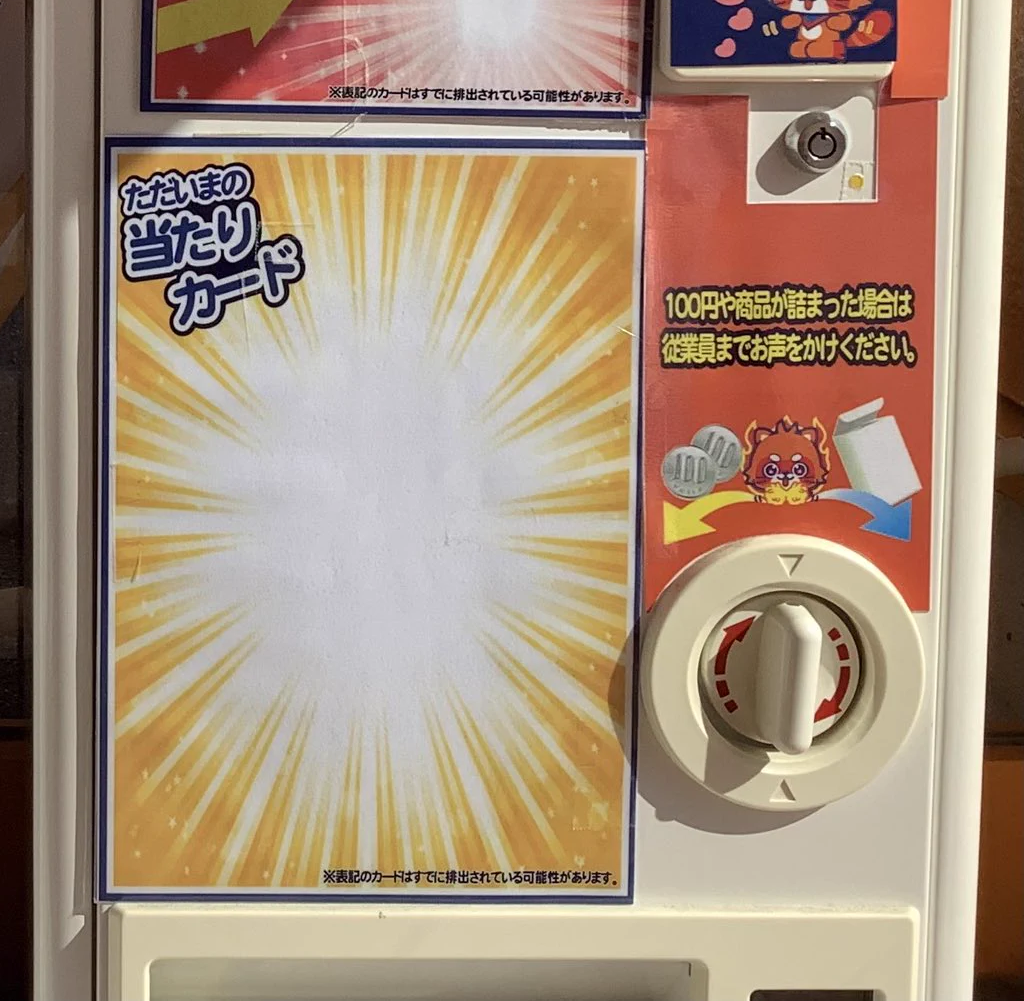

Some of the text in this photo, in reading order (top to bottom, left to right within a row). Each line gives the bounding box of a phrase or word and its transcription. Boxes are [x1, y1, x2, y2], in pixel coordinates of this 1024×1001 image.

[124, 169, 247, 211] ただいまの
[130, 205, 256, 275] 当たり
[175, 240, 298, 325] カード
[664, 286, 913, 320] 100円や商品が詰まった場合は
[661, 332, 916, 364] 従業員までお声をかけください。
